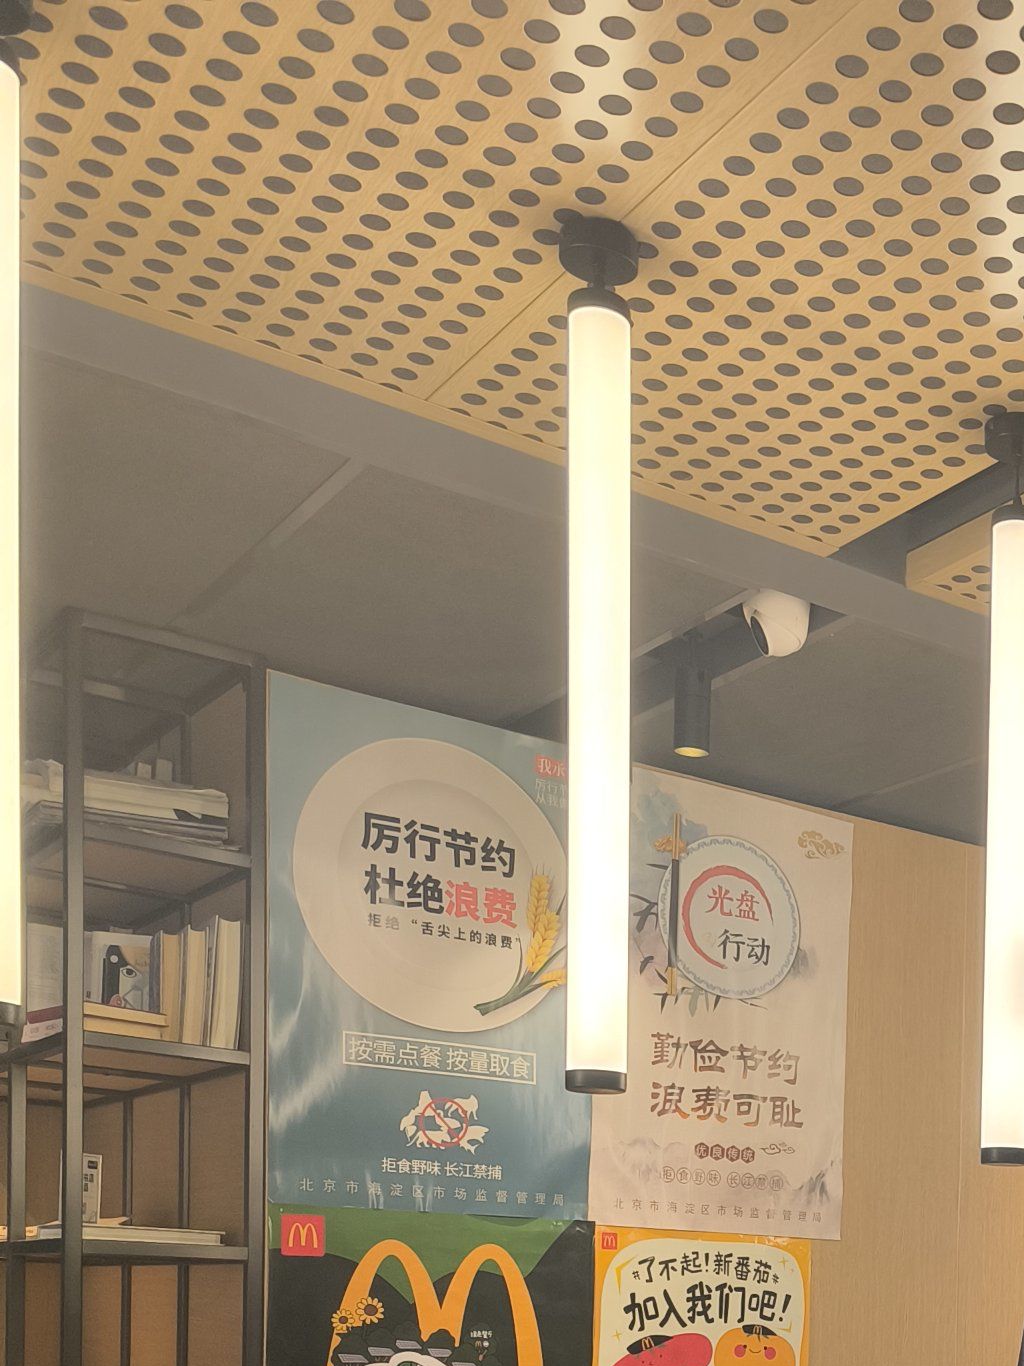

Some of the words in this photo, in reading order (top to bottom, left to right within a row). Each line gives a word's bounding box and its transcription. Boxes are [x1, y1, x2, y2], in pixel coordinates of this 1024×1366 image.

[361, 812, 516, 878] 厉行节约
[364, 863, 517, 928] 杜绝浪费
[705, 884, 760, 922] 光盘
[718, 928, 771, 966] 行动
[348, 1036, 442, 1069] 按需点餐
[447, 1047, 531, 1079] 按量取食
[650, 1031, 800, 1085] 勤俭节约
[650, 1081, 804, 1129] 浪费可耻
[381, 1157, 441, 1176] 拒食野味
[444, 1161, 503, 1181] 长江禁捕
[695, 1143, 755, 1162] 优良传统
[623, 1281, 792, 1332] 加入我们吧!
